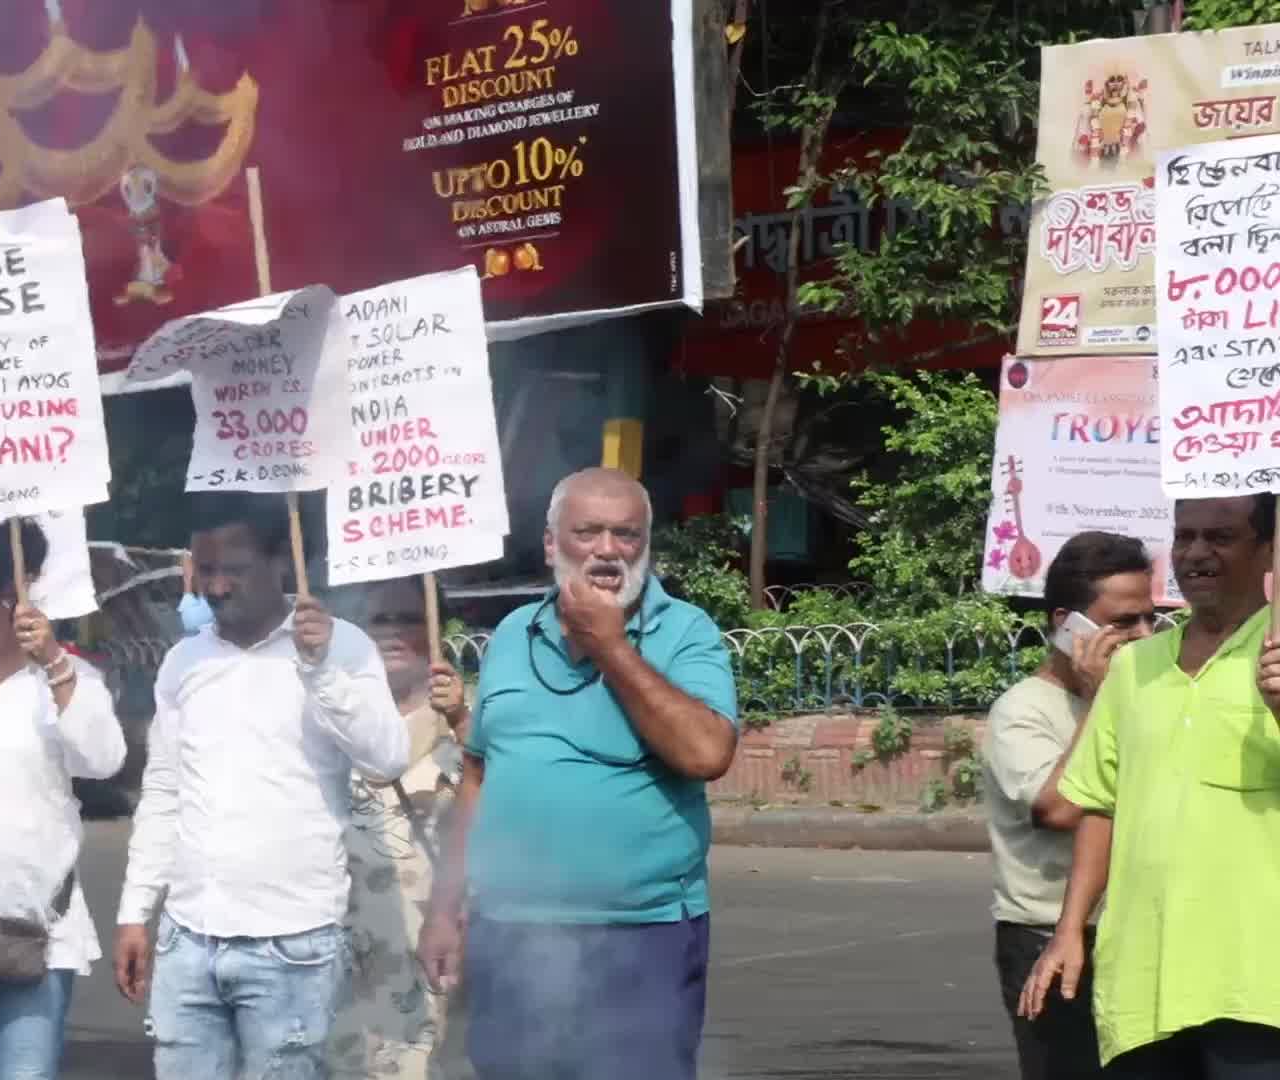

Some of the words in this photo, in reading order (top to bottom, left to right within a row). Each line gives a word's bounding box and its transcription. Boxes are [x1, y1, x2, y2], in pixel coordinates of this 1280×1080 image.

[424, 46, 496, 86] FLAT
[503, 19, 578, 69] 25%
[441, 66, 556, 108] DISCOUNT
[423, 115, 441, 129] ON
[444, 103, 496, 127] MAKING
[497, 92, 555, 115] CHARGES
[556, 89, 575, 104] OF
[467, 116, 527, 141] DIAMOND
[528, 103, 600, 129] JEWELLERY
[451, 185, 566, 223] DISCOUNT
[458, 225, 476, 238] ON
[478, 217, 525, 234] ASTRAL
[527, 212, 561, 227] GEMS
[345, 296, 407, 321] ADANI
[1041, 298, 1080, 325] 24
[28, 335, 49, 349] OF
[366, 313, 452, 348] SOLAR
[17, 371, 72, 392] AYOG
[360, 418, 437, 447] UNDER
[233, 440, 316, 461] CRORES
[372, 445, 439, 474] 2000
[348, 473, 480, 512] BRIBERY
[1072, 503, 1136, 519] November
[1137, 506, 1168, 520] 2025
